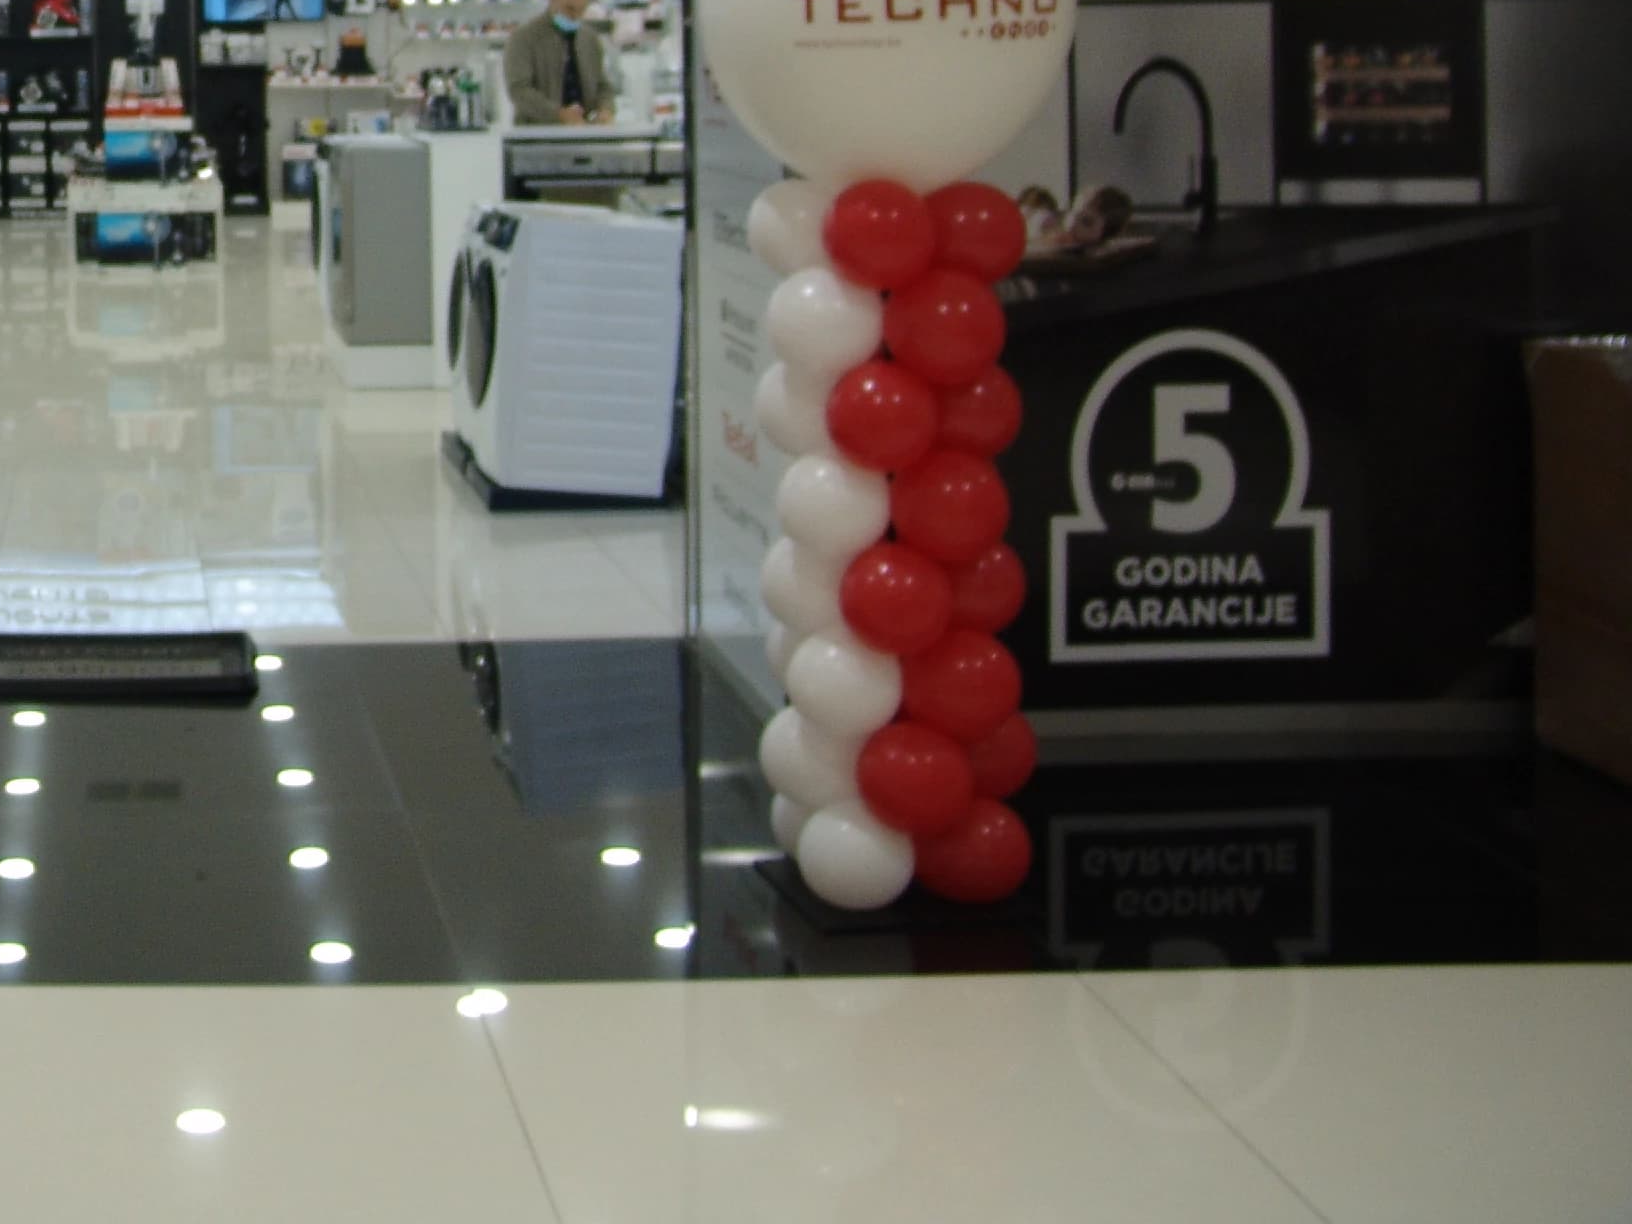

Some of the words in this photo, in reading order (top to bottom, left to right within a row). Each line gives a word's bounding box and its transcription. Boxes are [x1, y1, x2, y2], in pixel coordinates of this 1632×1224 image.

[1152, 382, 1237, 534] 5
[1116, 554, 1265, 588] GODINA
[1082, 594, 1298, 629] GARANCIJE
